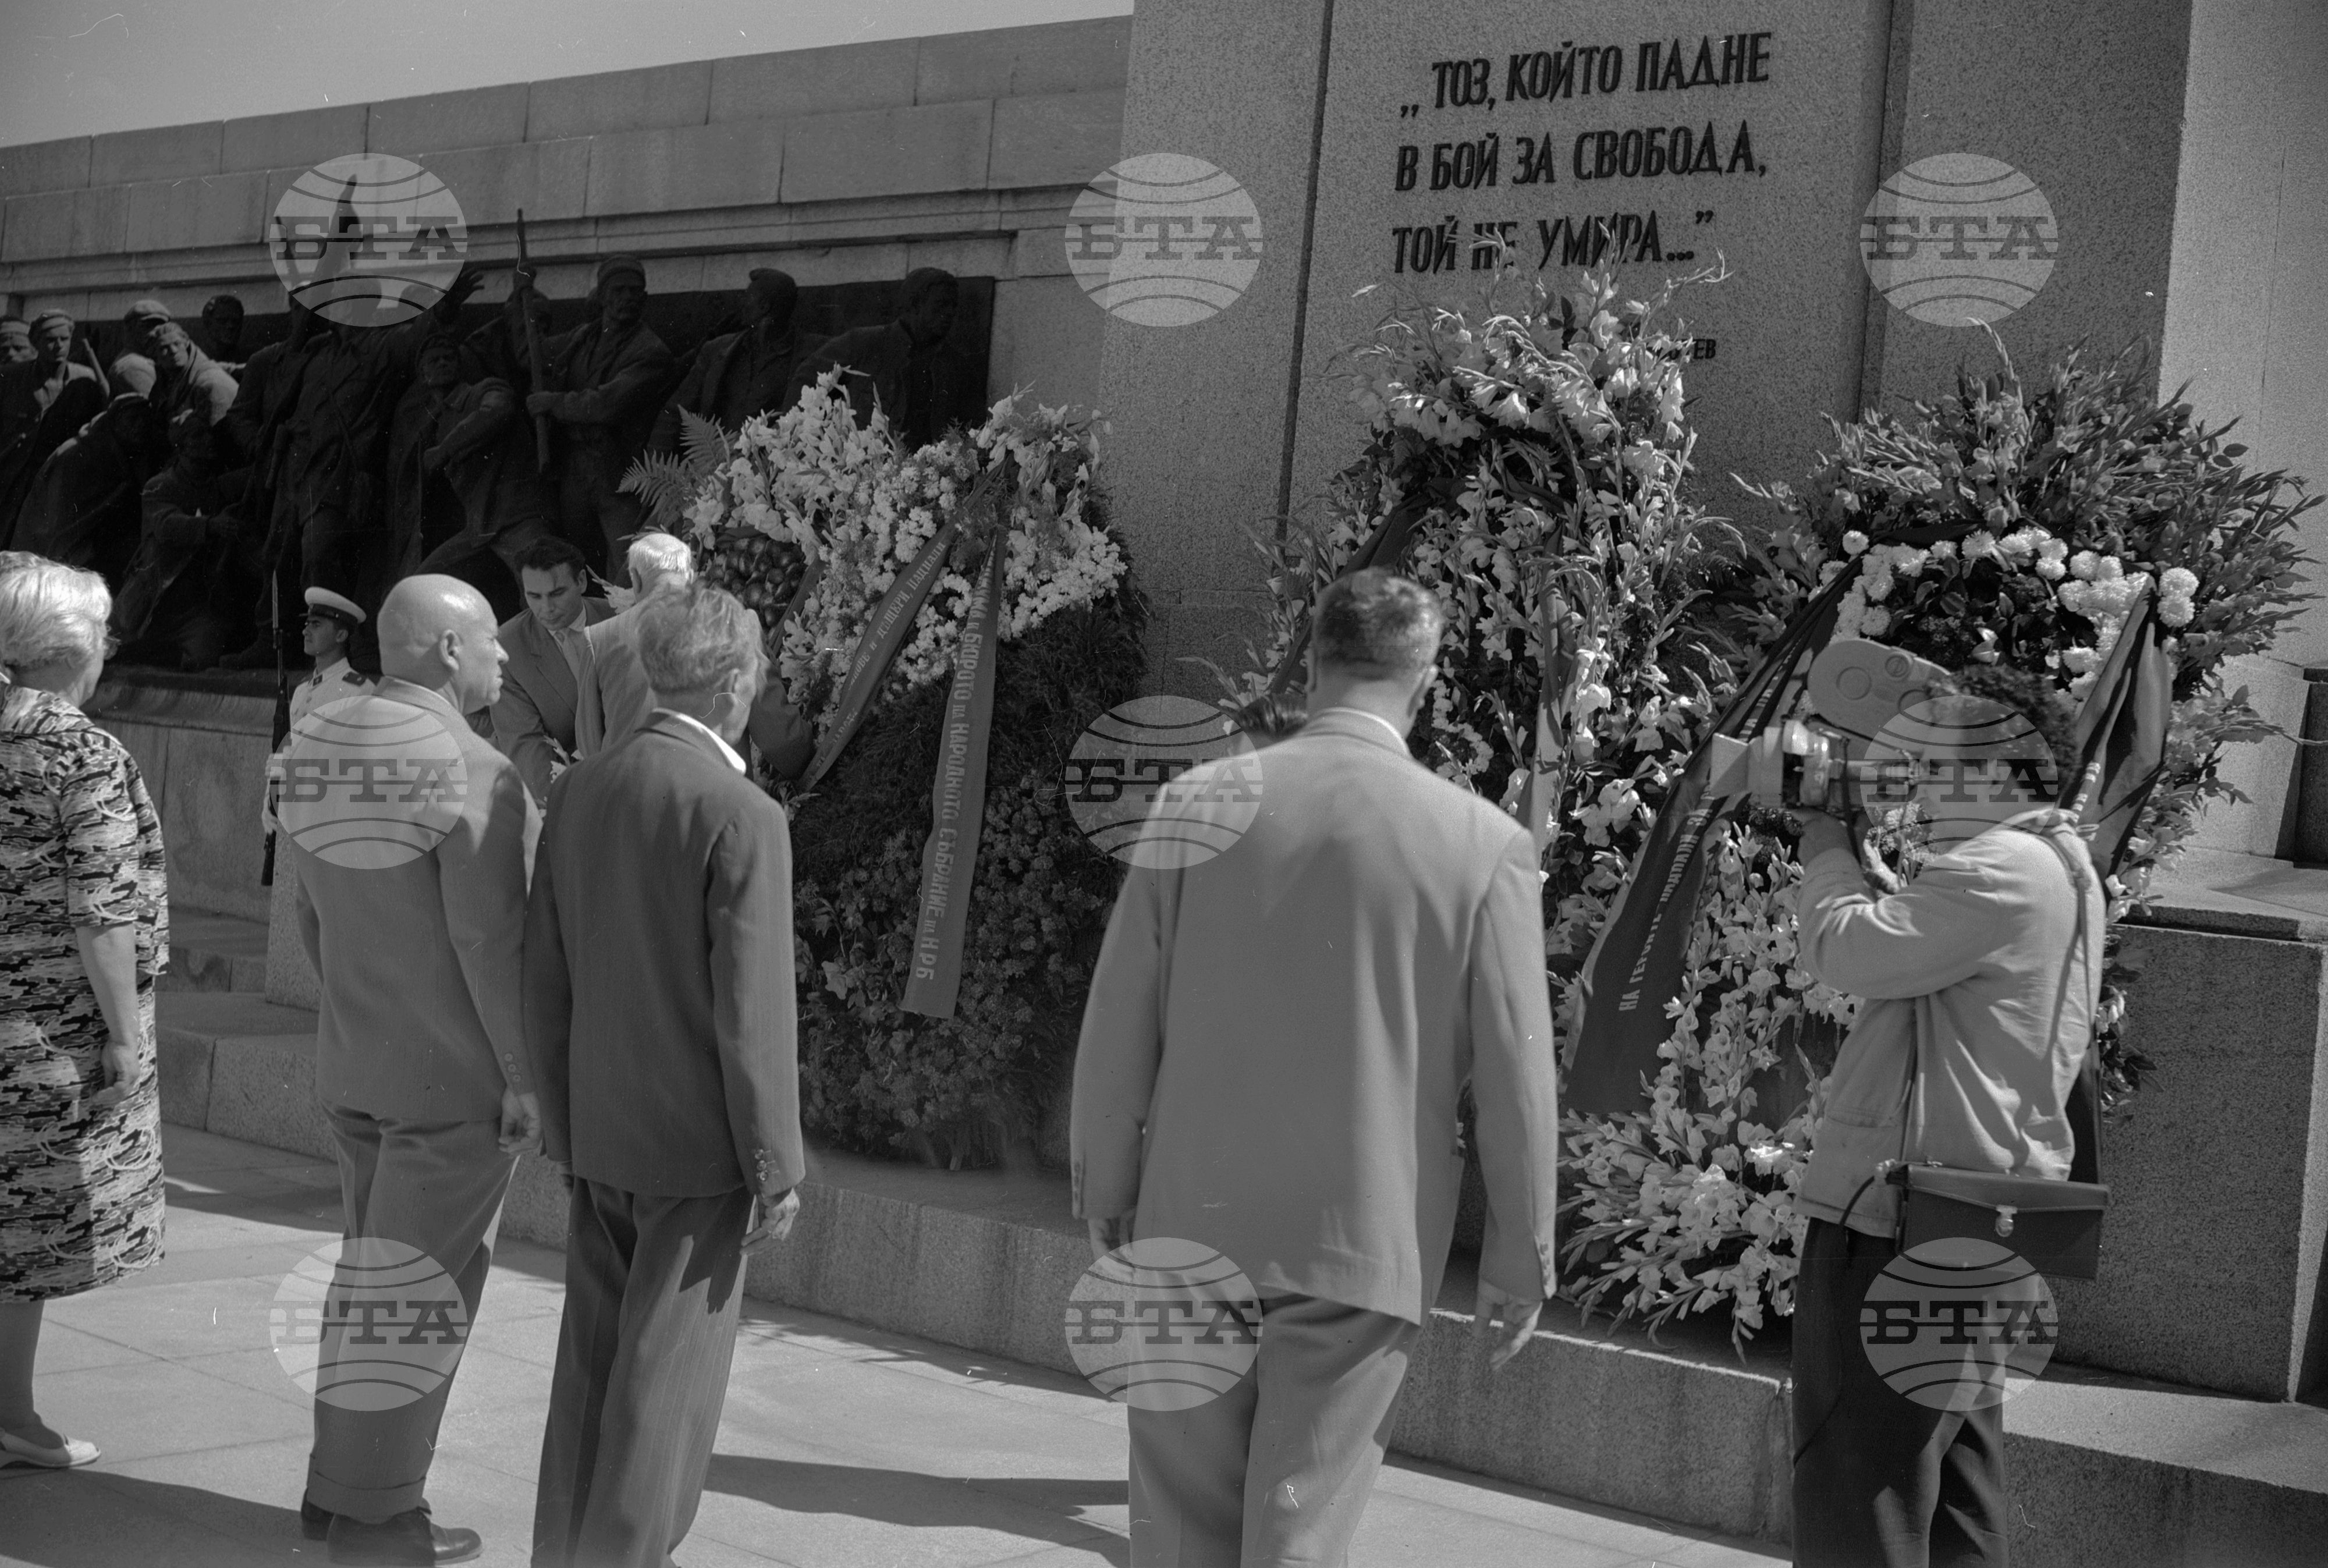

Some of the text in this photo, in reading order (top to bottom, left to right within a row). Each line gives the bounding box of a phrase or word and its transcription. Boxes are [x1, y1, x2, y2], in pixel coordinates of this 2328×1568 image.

[1505, 41, 1623, 102] КОЙТО
[1635, 32, 1772, 91] ПАДНЕ
[1396, 119, 1766, 191] В БОЙ ЗА СВОБОДА,
[1393, 215, 1459, 274] ТОЙ
[1471, 221, 1517, 271] НЕ
[954, 632, 983, 700] БЮРОТО
[952, 704, 966, 719] НА
[942, 722, 970, 820] НАРОДНОТО
[926, 827, 958, 918] СЪБРАНИЕ
[1619, 989, 1640, 1011] НА
